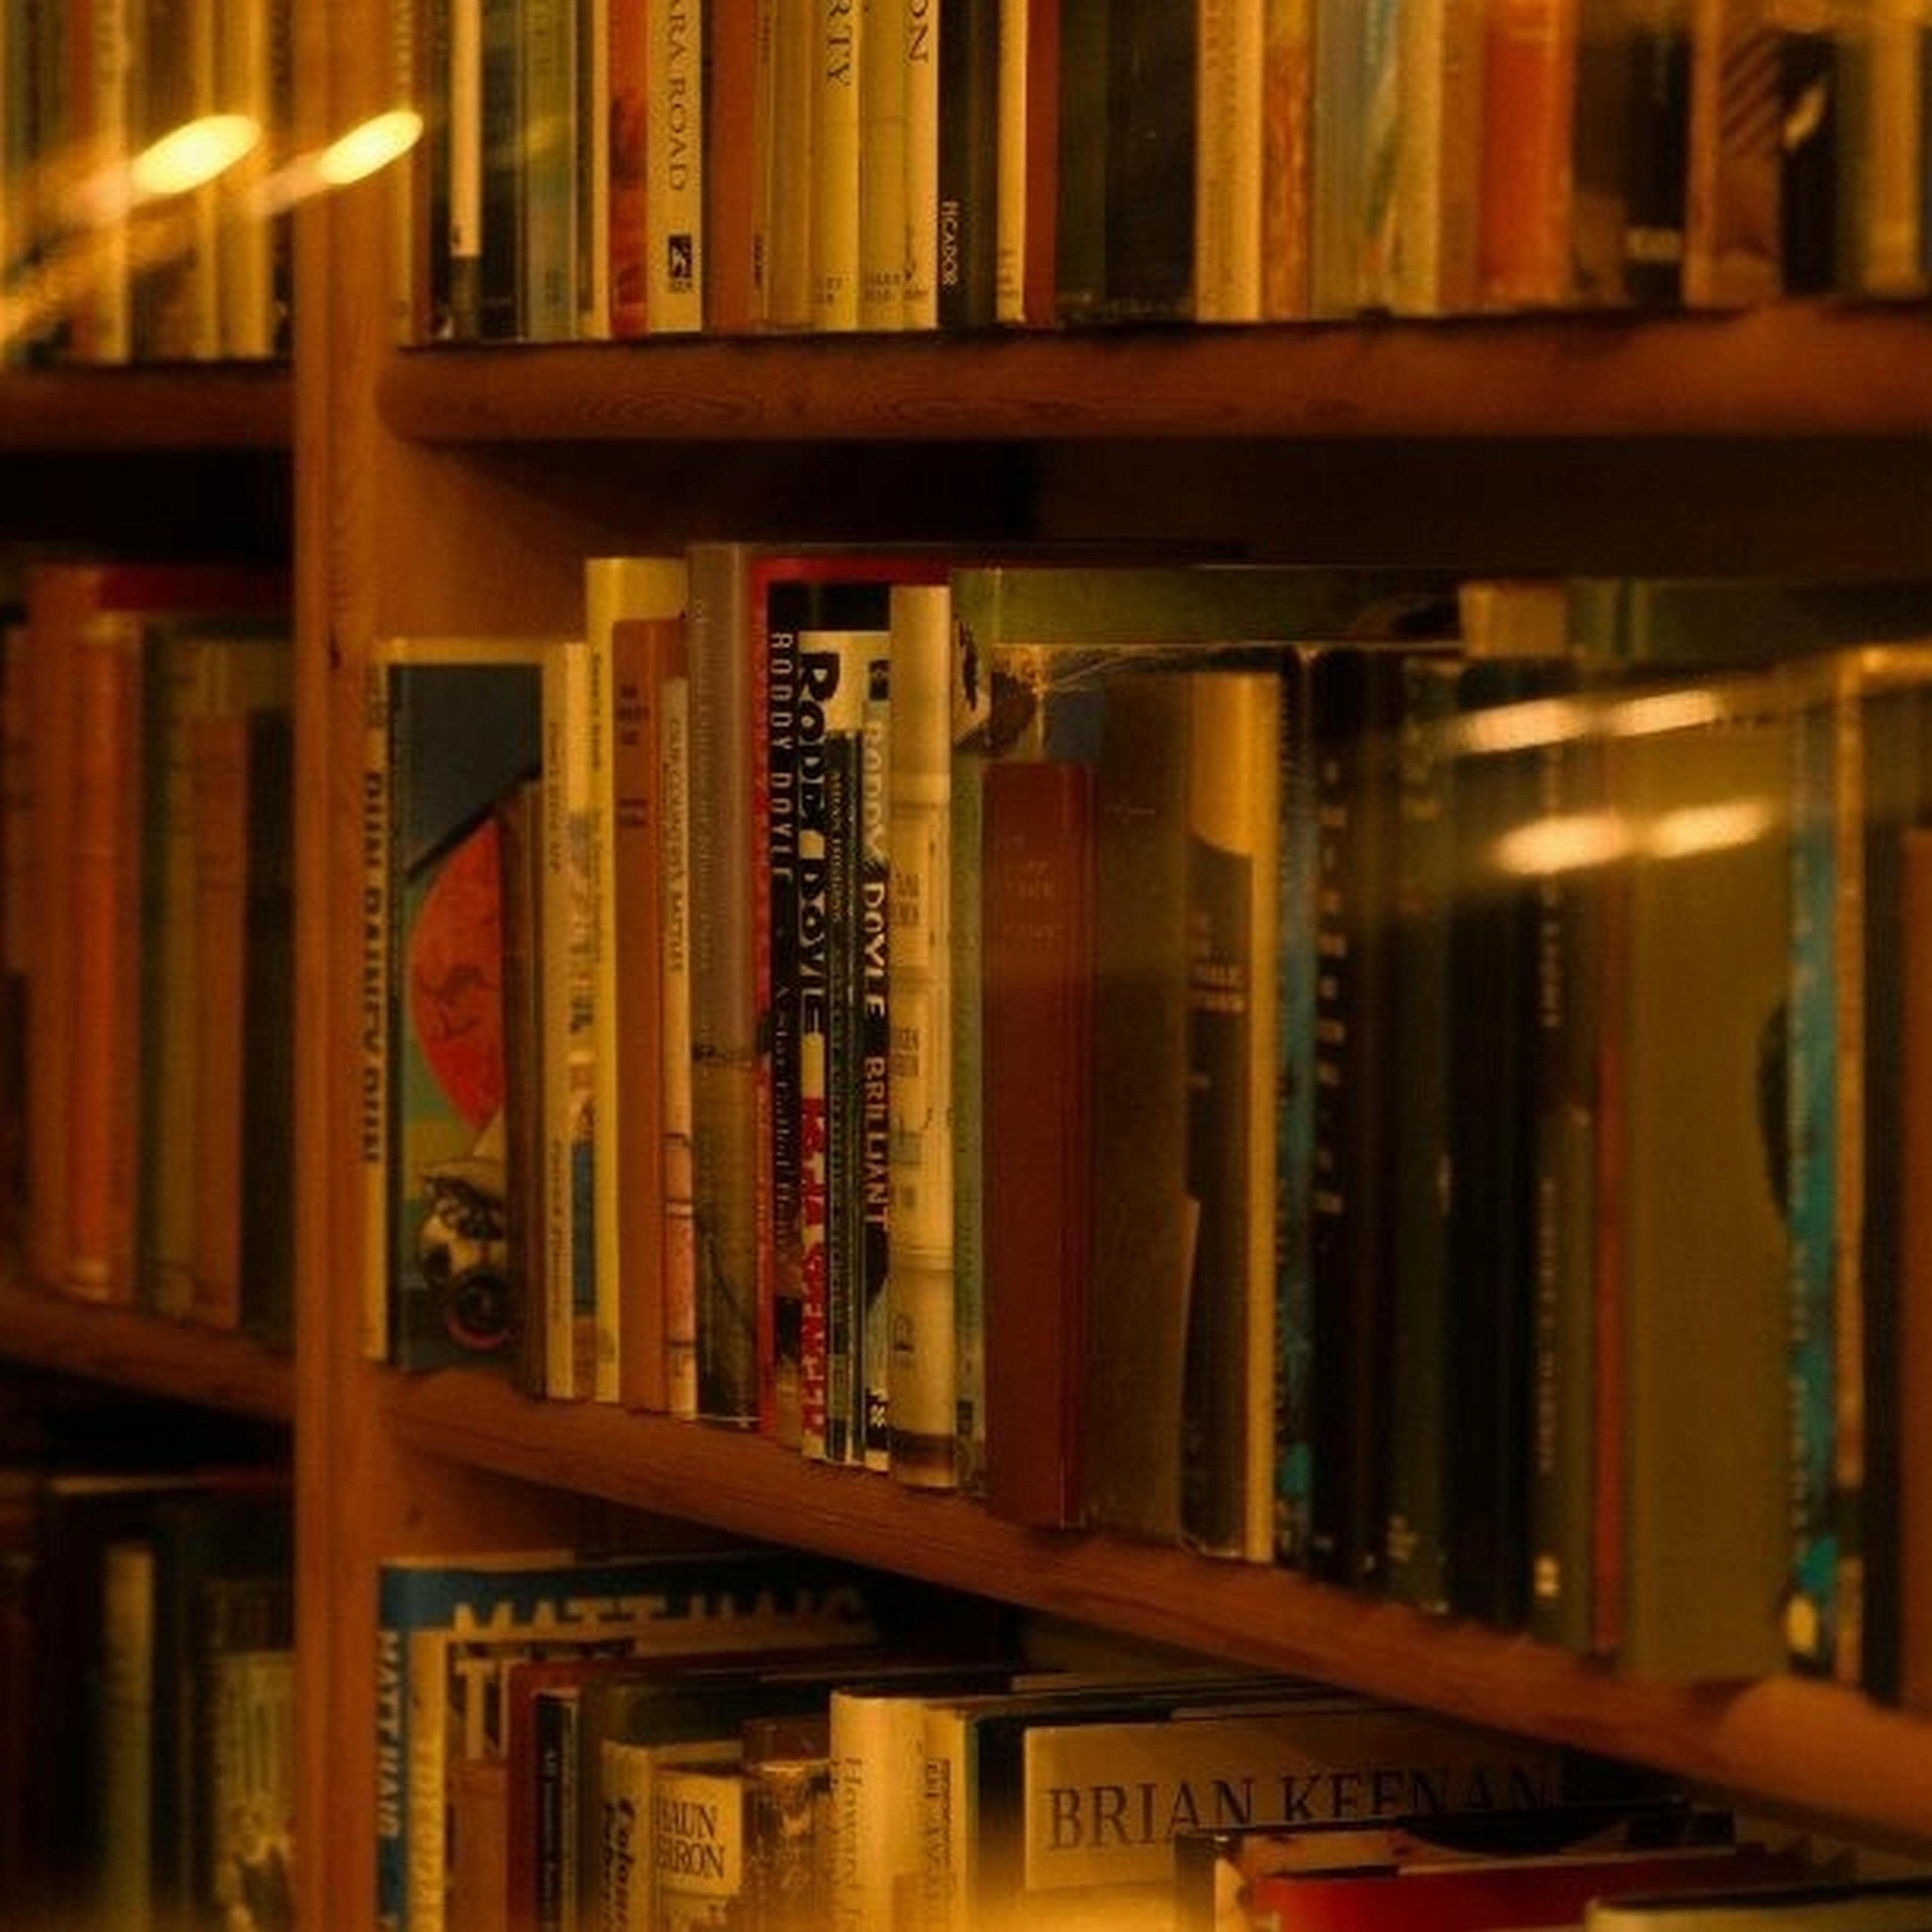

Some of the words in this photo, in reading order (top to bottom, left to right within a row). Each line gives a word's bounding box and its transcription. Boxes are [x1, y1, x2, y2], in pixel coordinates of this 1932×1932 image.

[669, 77, 687, 192] ROAD
[941, 200, 959, 286] PICADOR
[770, 631, 794, 749] RODDY
[798, 653, 840, 829] RODDY
[770, 770, 794, 881] DOYLE
[862, 719, 884, 859] RODDY
[798, 858, 827, 1033] DOYLE
[862, 882, 887, 1020] DOYLE
[862, 1056, 890, 1231] BRILLIANT
[1049, 1776, 1255, 1852] BRIAN
[1280, 1762, 1566, 1821] KEENAN
